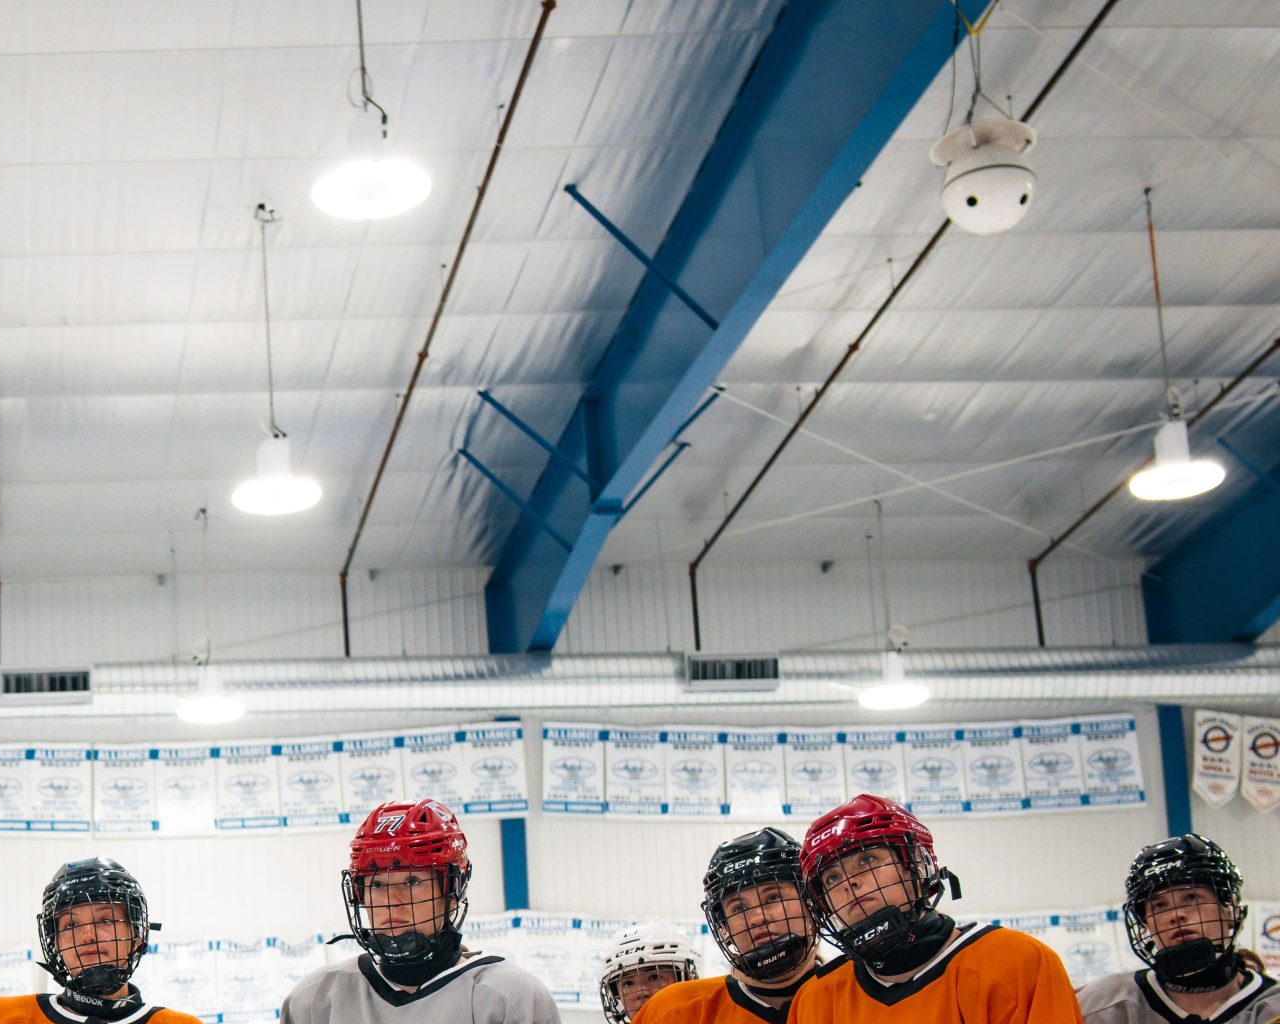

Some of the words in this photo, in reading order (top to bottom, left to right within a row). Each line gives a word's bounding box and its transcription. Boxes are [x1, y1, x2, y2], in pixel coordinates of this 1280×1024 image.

[374, 815, 406, 834] 77
[811, 821, 844, 847] CCM
[723, 856, 761, 874] CCM
[1144, 859, 1182, 876] CCM
[853, 921, 890, 946] CCM
[616, 945, 646, 958] CCM
